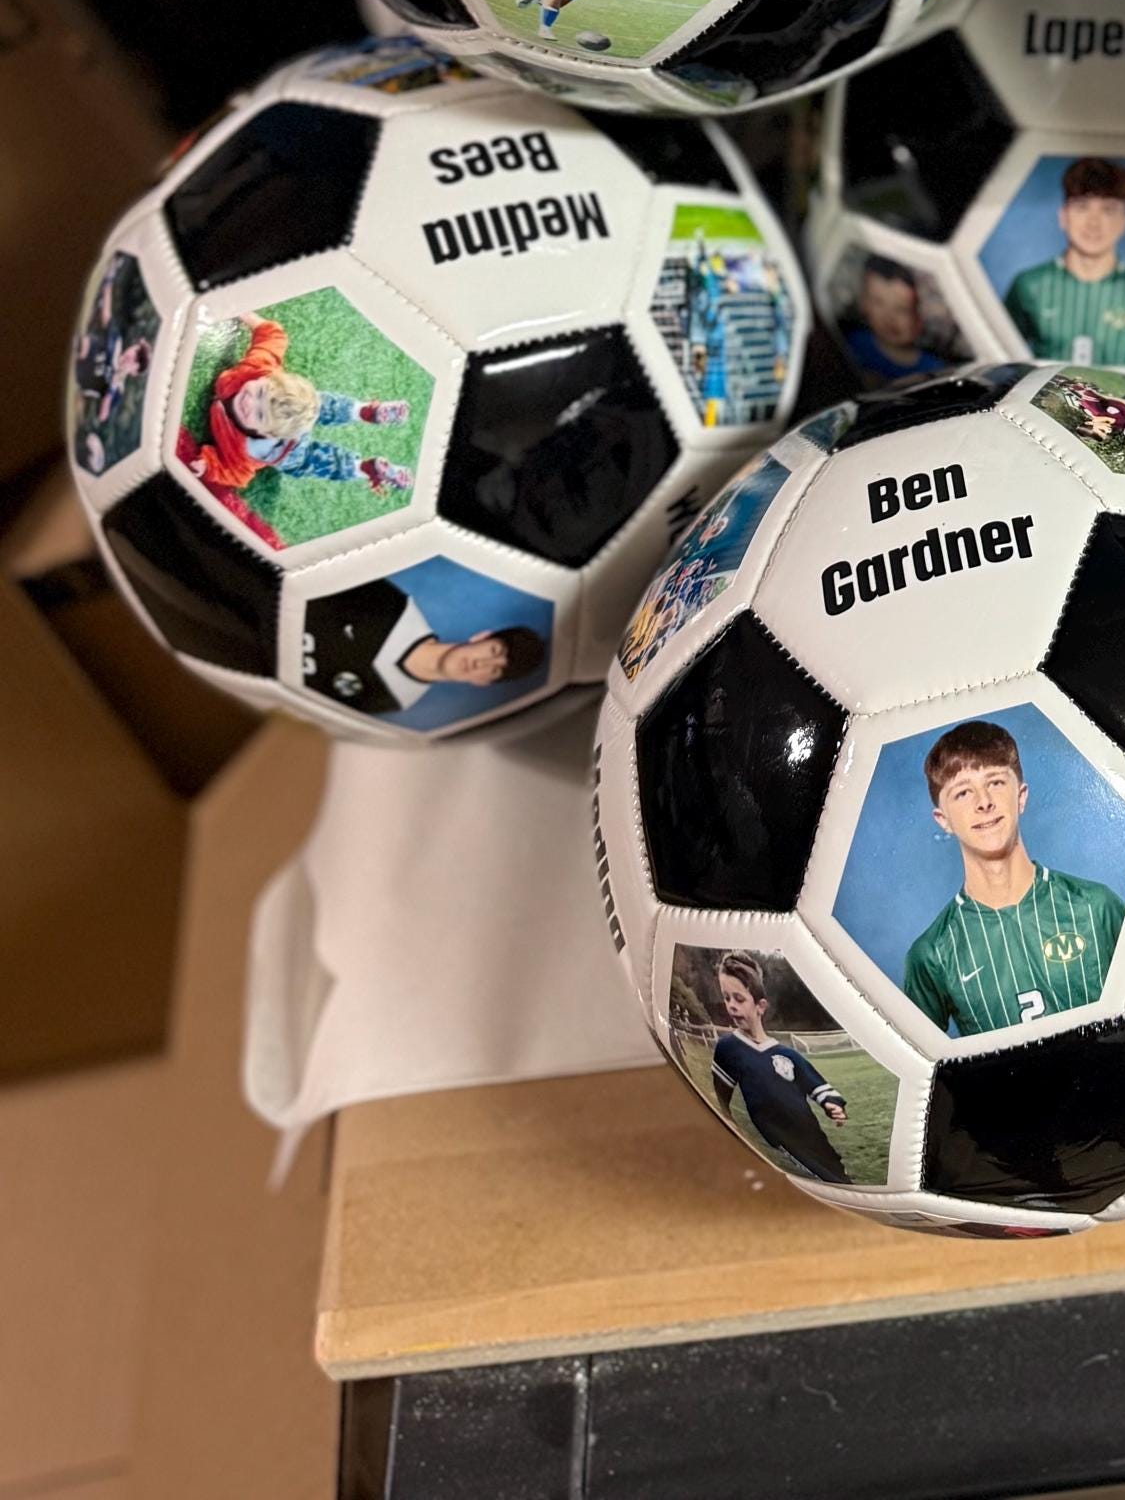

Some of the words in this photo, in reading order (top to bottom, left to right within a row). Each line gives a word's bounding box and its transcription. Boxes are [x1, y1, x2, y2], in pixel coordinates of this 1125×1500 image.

[429, 131, 559, 185] Bees
[422, 193, 609, 265] Medina
[867, 462, 968, 524] Ben
[821, 513, 1034, 617] Gardner
